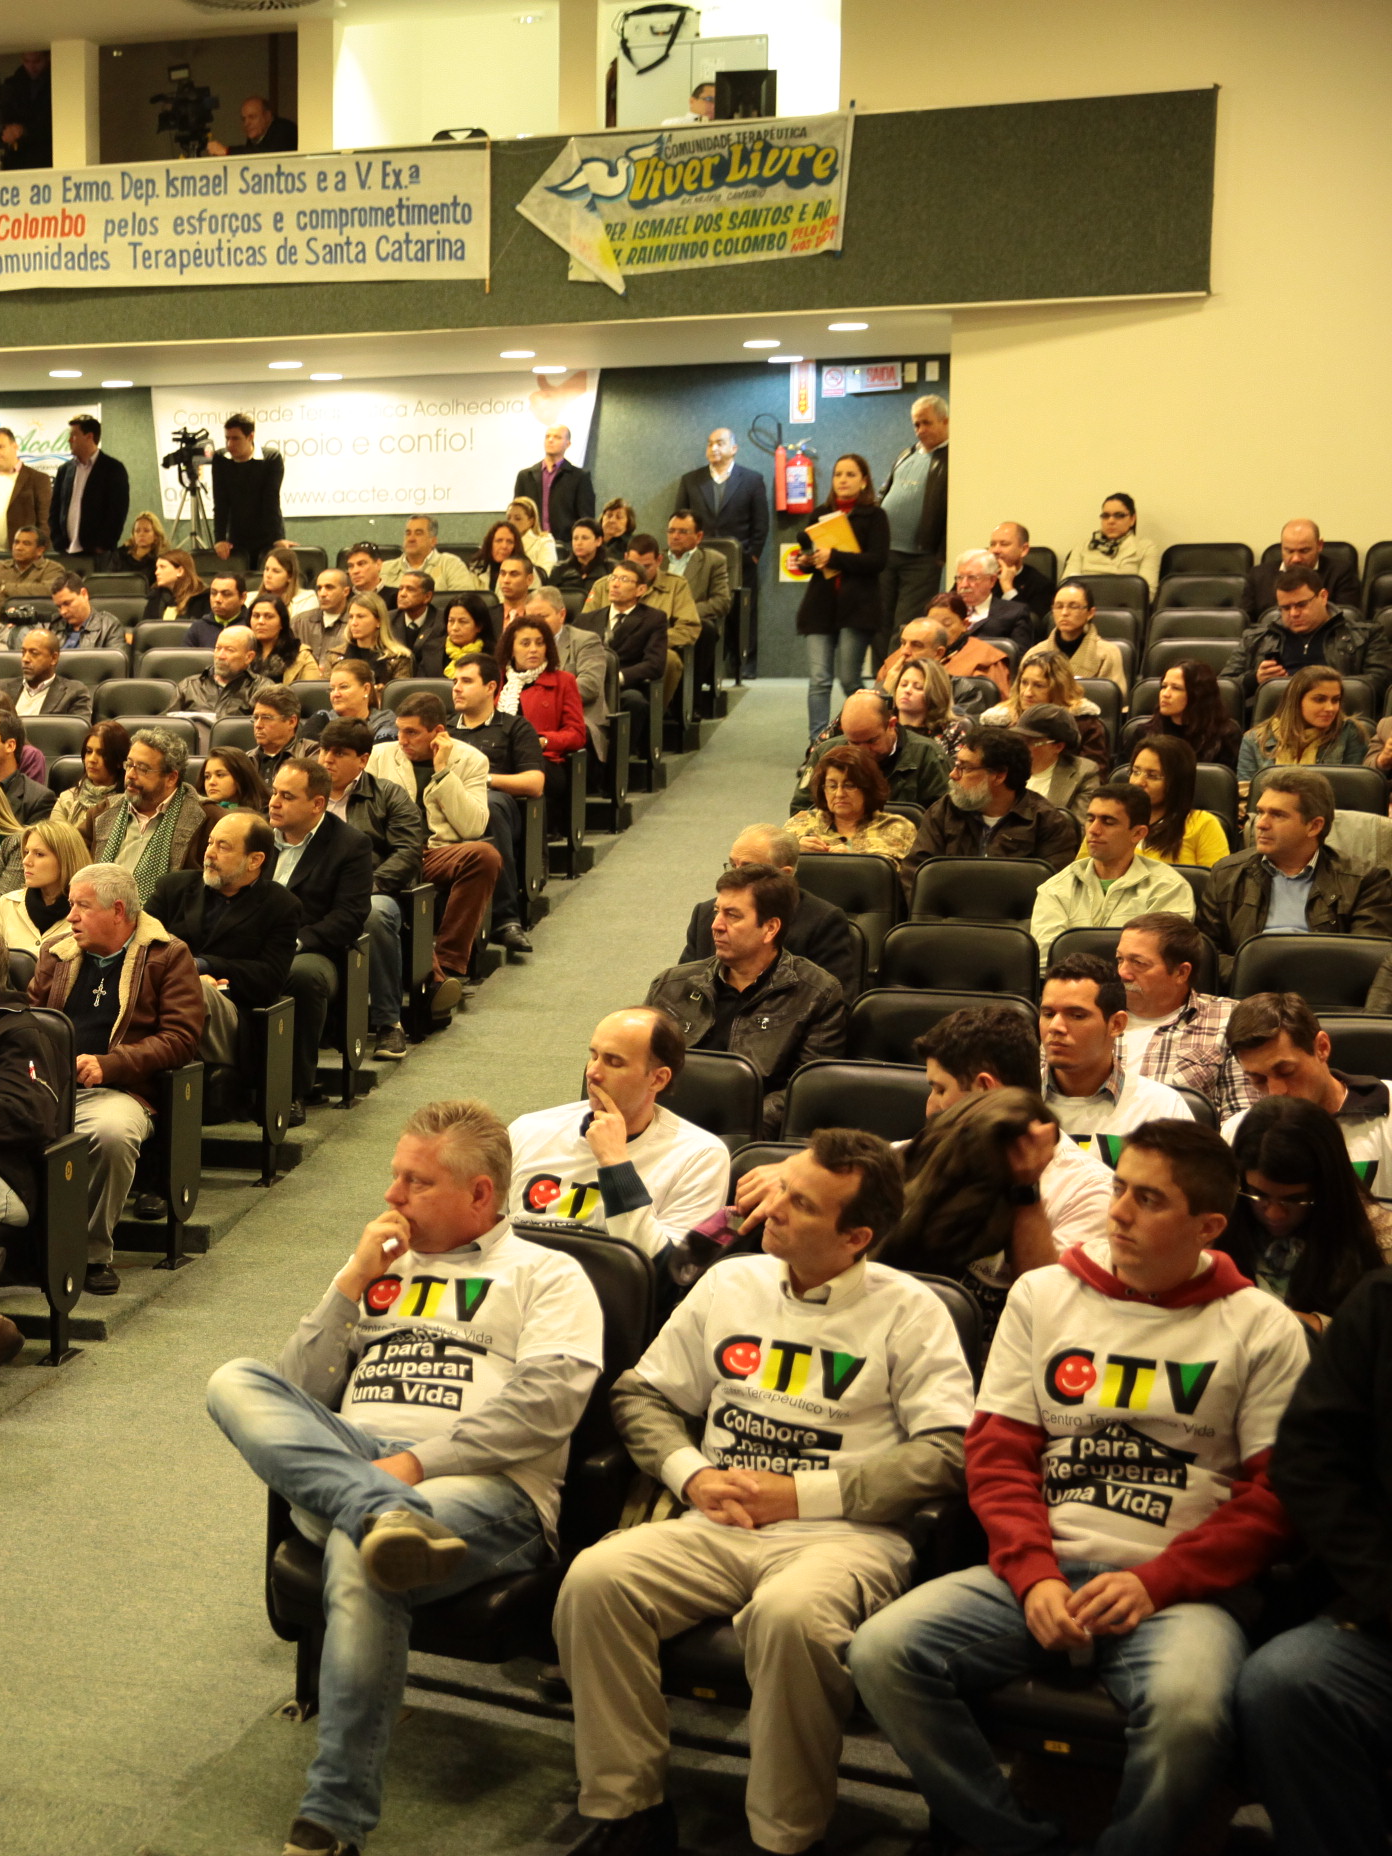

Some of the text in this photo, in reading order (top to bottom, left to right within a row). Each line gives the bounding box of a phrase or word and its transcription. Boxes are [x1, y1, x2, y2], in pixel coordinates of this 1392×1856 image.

[664, 133, 732, 159] COMUNIDADE
[29, 184, 51, 206] ao
[120, 171, 160, 206] Dep.
[165, 165, 228, 198] Ismael
[238, 164, 307, 195] Santos
[316, 170, 328, 192] e
[334, 170, 346, 192] a
[355, 161, 372, 190] V.
[628, 141, 838, 201] Viver Livre
[103, 212, 159, 244] pelos
[173, 208, 263, 238] esforços
[273, 211, 284, 232] e
[296, 195, 472, 236] comprometimento
[632, 216, 689, 240] ISMAEL
[693, 212, 723, 234] DOS
[727, 205, 794, 231] SANTOS
[798, 203, 809, 222] E
[812, 201, 832, 221] AO
[276, 237, 298, 265] de
[305, 235, 367, 265] Santa
[375, 230, 466, 262] Catarina
[626, 239, 709, 265] RAIMUNDO
[713, 231, 787, 257] COLOMBO
[414, 397, 524, 418] Acolhedora
[264, 427, 474, 462] apoio e confio!
[283, 485, 452, 505] www.accte.org.br
[363, 1273, 495, 1322] CTV
[384, 1342, 435, 1360] para
[464, 1328, 494, 1345] Vida
[355, 1360, 470, 1380] Recuperar
[713, 1334, 867, 1402] CTV
[1044, 1347, 1219, 1415] CTV
[353, 1382, 460, 1407] uma Vida
[723, 1408, 818, 1447] Colabore
[1041, 1409, 1083, 1428] Centro
[1182, 1421, 1216, 1438] Vida
[1079, 1437, 1141, 1460] para
[1046, 1456, 1183, 1485] Recuperar
[1046, 1485, 1166, 1520] uma Vida
